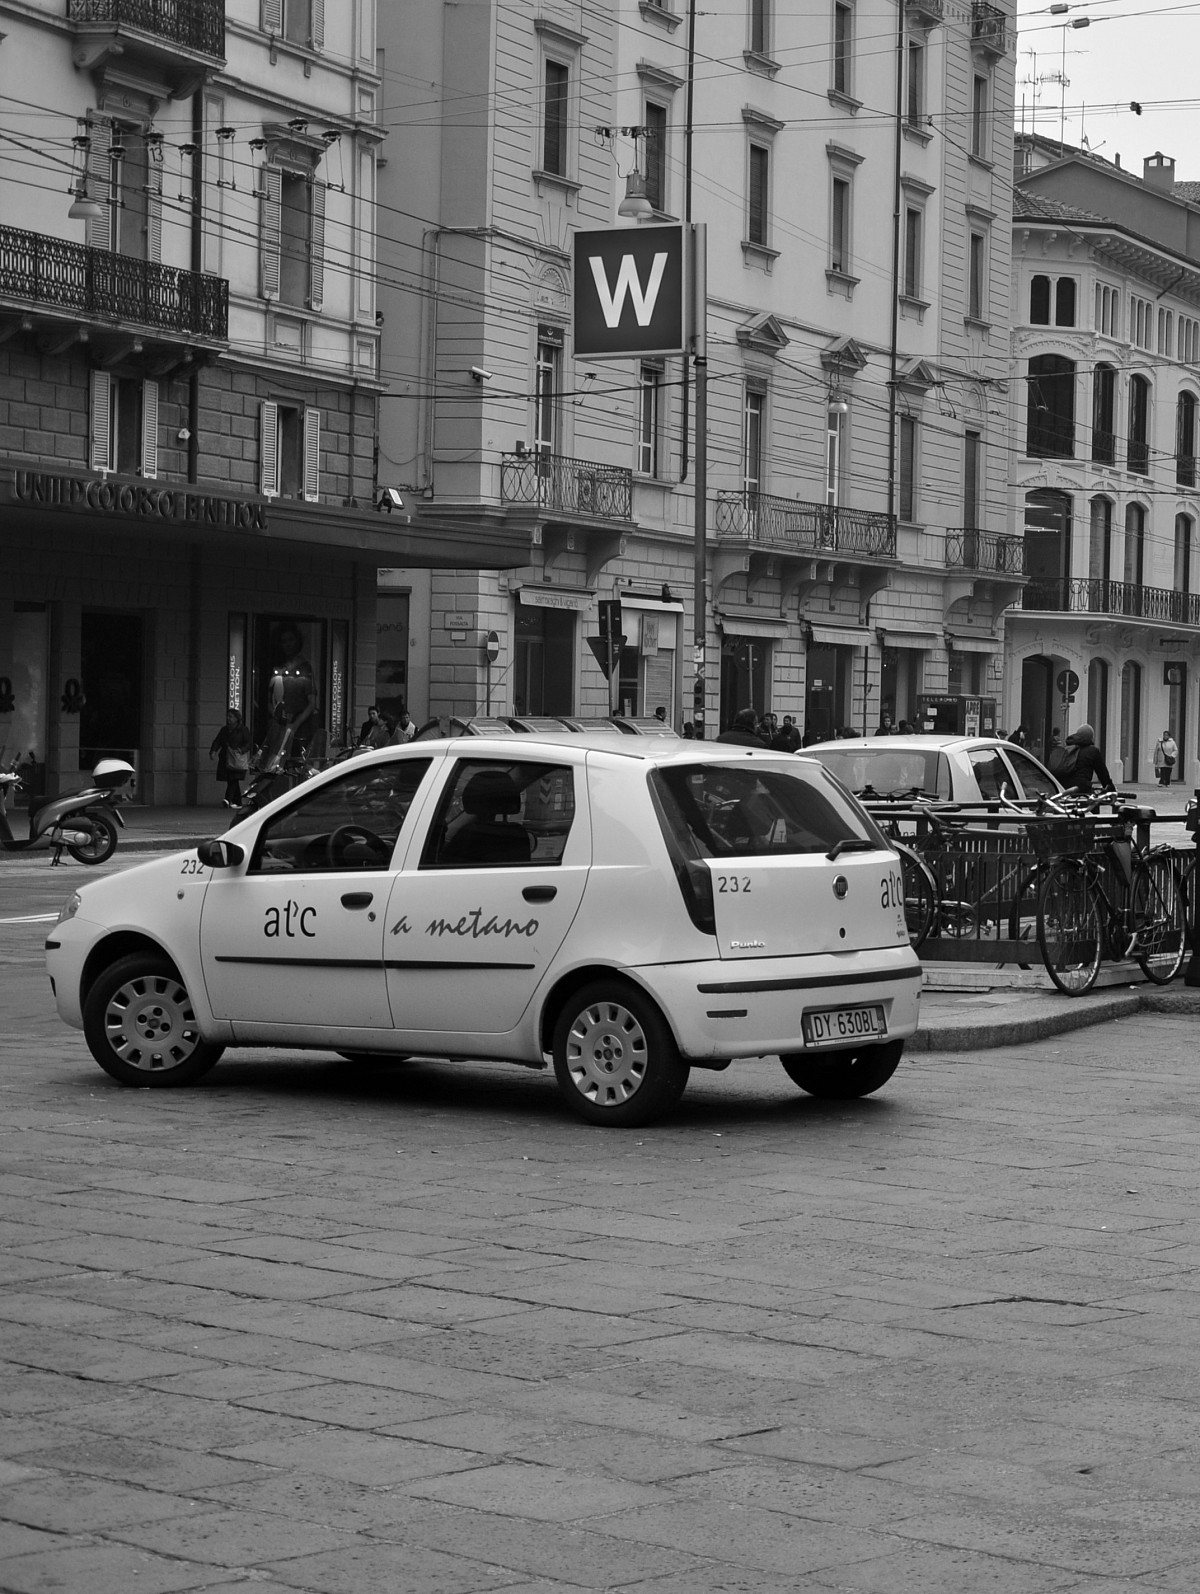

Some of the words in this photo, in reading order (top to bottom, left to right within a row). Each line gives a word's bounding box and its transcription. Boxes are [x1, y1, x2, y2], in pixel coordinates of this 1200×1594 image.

[149, 147, 164, 162] 13
[588, 252, 669, 328] W
[14, 469, 84, 503] UNITED
[86, 479, 154, 515] COLORS
[180, 859, 206, 874] 232
[718, 876, 752, 893] 232
[390, 915, 412, 936] a
[425, 907, 540, 939] metano
[730, 940, 766, 950] Punto
[813, 1013, 832, 1039] DY
